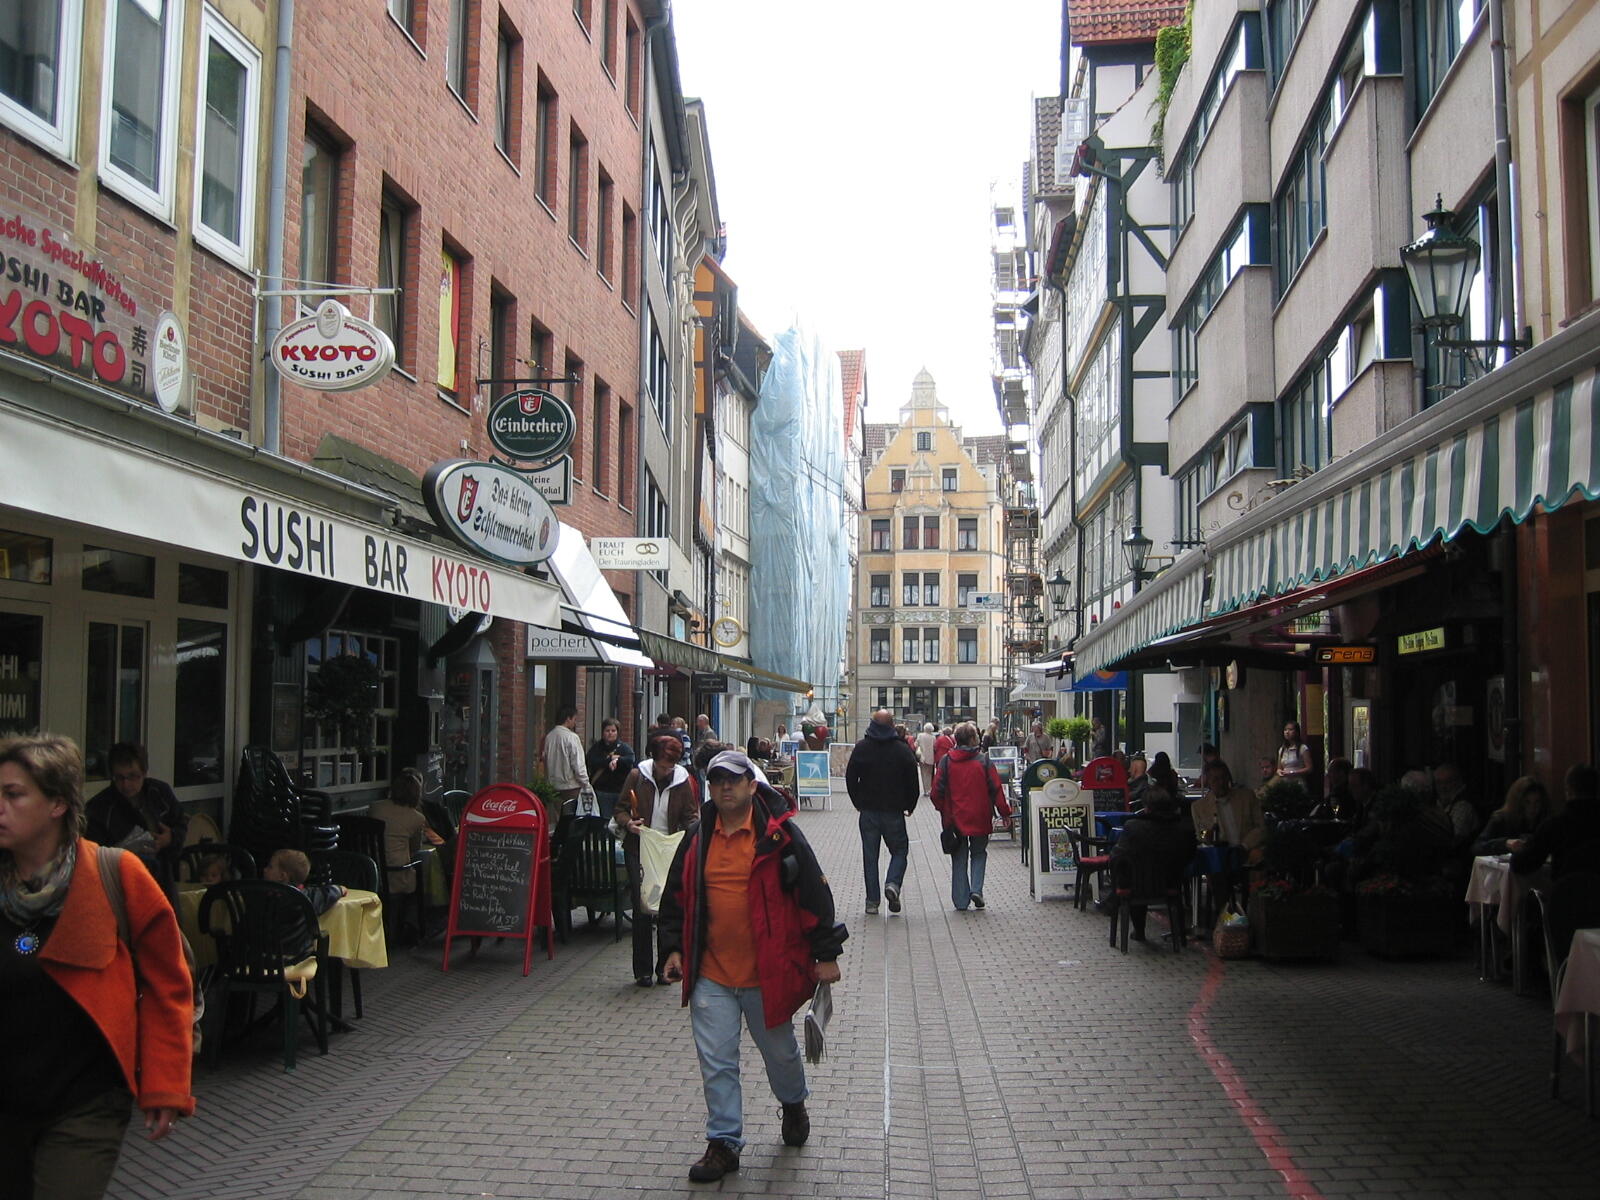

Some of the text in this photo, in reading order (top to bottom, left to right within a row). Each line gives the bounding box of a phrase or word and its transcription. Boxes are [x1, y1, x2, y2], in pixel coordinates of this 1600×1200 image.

[41, 228, 137, 317] Spezialitäten
[57, 279, 106, 323] BAR
[281, 344, 377, 361] KYOTO
[290, 364, 366, 380] SUSHI BAR
[491, 476, 533, 518] Das kleine
[473, 506, 536, 552] Schlemmerlokal
[241, 495, 491, 612] SUSHI BAR KYOTO
[598, 541, 625, 549] TRAUT
[598, 558, 660, 568] Der Trauringladen
[531, 633, 588, 651] pochert
[1320, 649, 1373, 662] arena
[1040, 807, 1087, 818] HAPPY
[1045, 817, 1083, 829] HOUR
